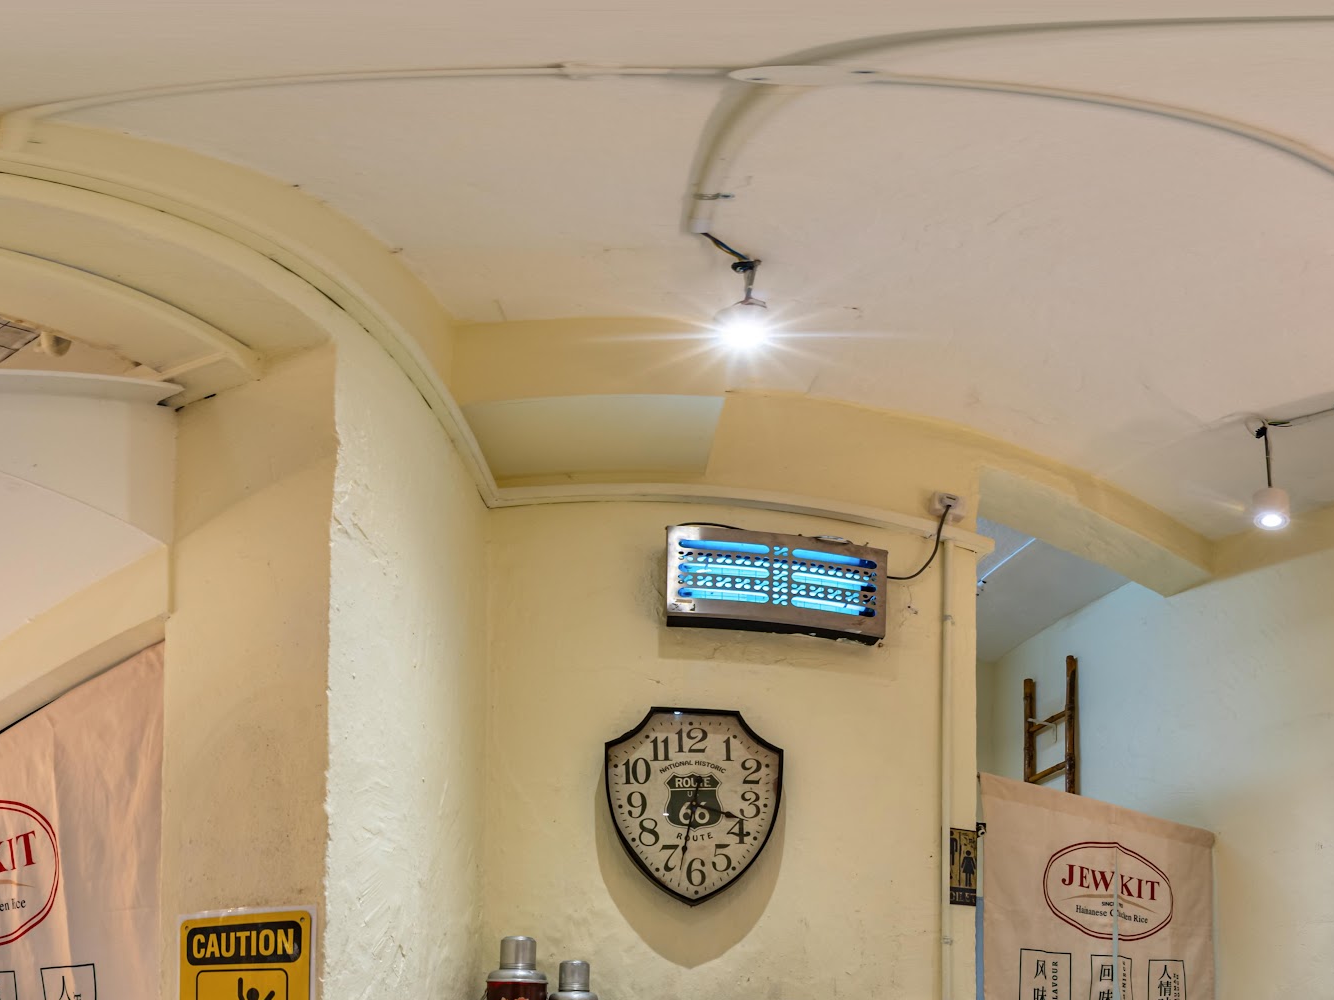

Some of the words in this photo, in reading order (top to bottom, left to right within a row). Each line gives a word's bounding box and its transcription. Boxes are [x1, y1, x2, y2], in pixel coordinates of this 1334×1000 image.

[650, 735, 673, 761] 11
[675, 727, 708, 753] 12
[722, 736, 734, 761] 1
[622, 757, 651, 785] 10
[659, 760, 693, 774] NATIONAL
[694, 760, 727, 774] HISTORIC
[741, 758, 762, 785] 2
[675, 777, 711, 788] ROUE
[627, 791, 647, 818] 9
[679, 801, 710, 824] 66
[739, 790, 760, 818] 3
[638, 818, 660, 846] 8
[726, 818, 751, 845] 4
[659, 844, 679, 873] 7
[686, 857, 706, 886] 6
[712, 844, 732, 872] 5
[1061, 863, 1115, 892] JEW
[1119, 873, 1160, 901] KIT
[1075, 904, 1107, 917] Hainanese
[1133, 914, 1149, 924] Rice
[192, 928, 295, 959] CAUTION
